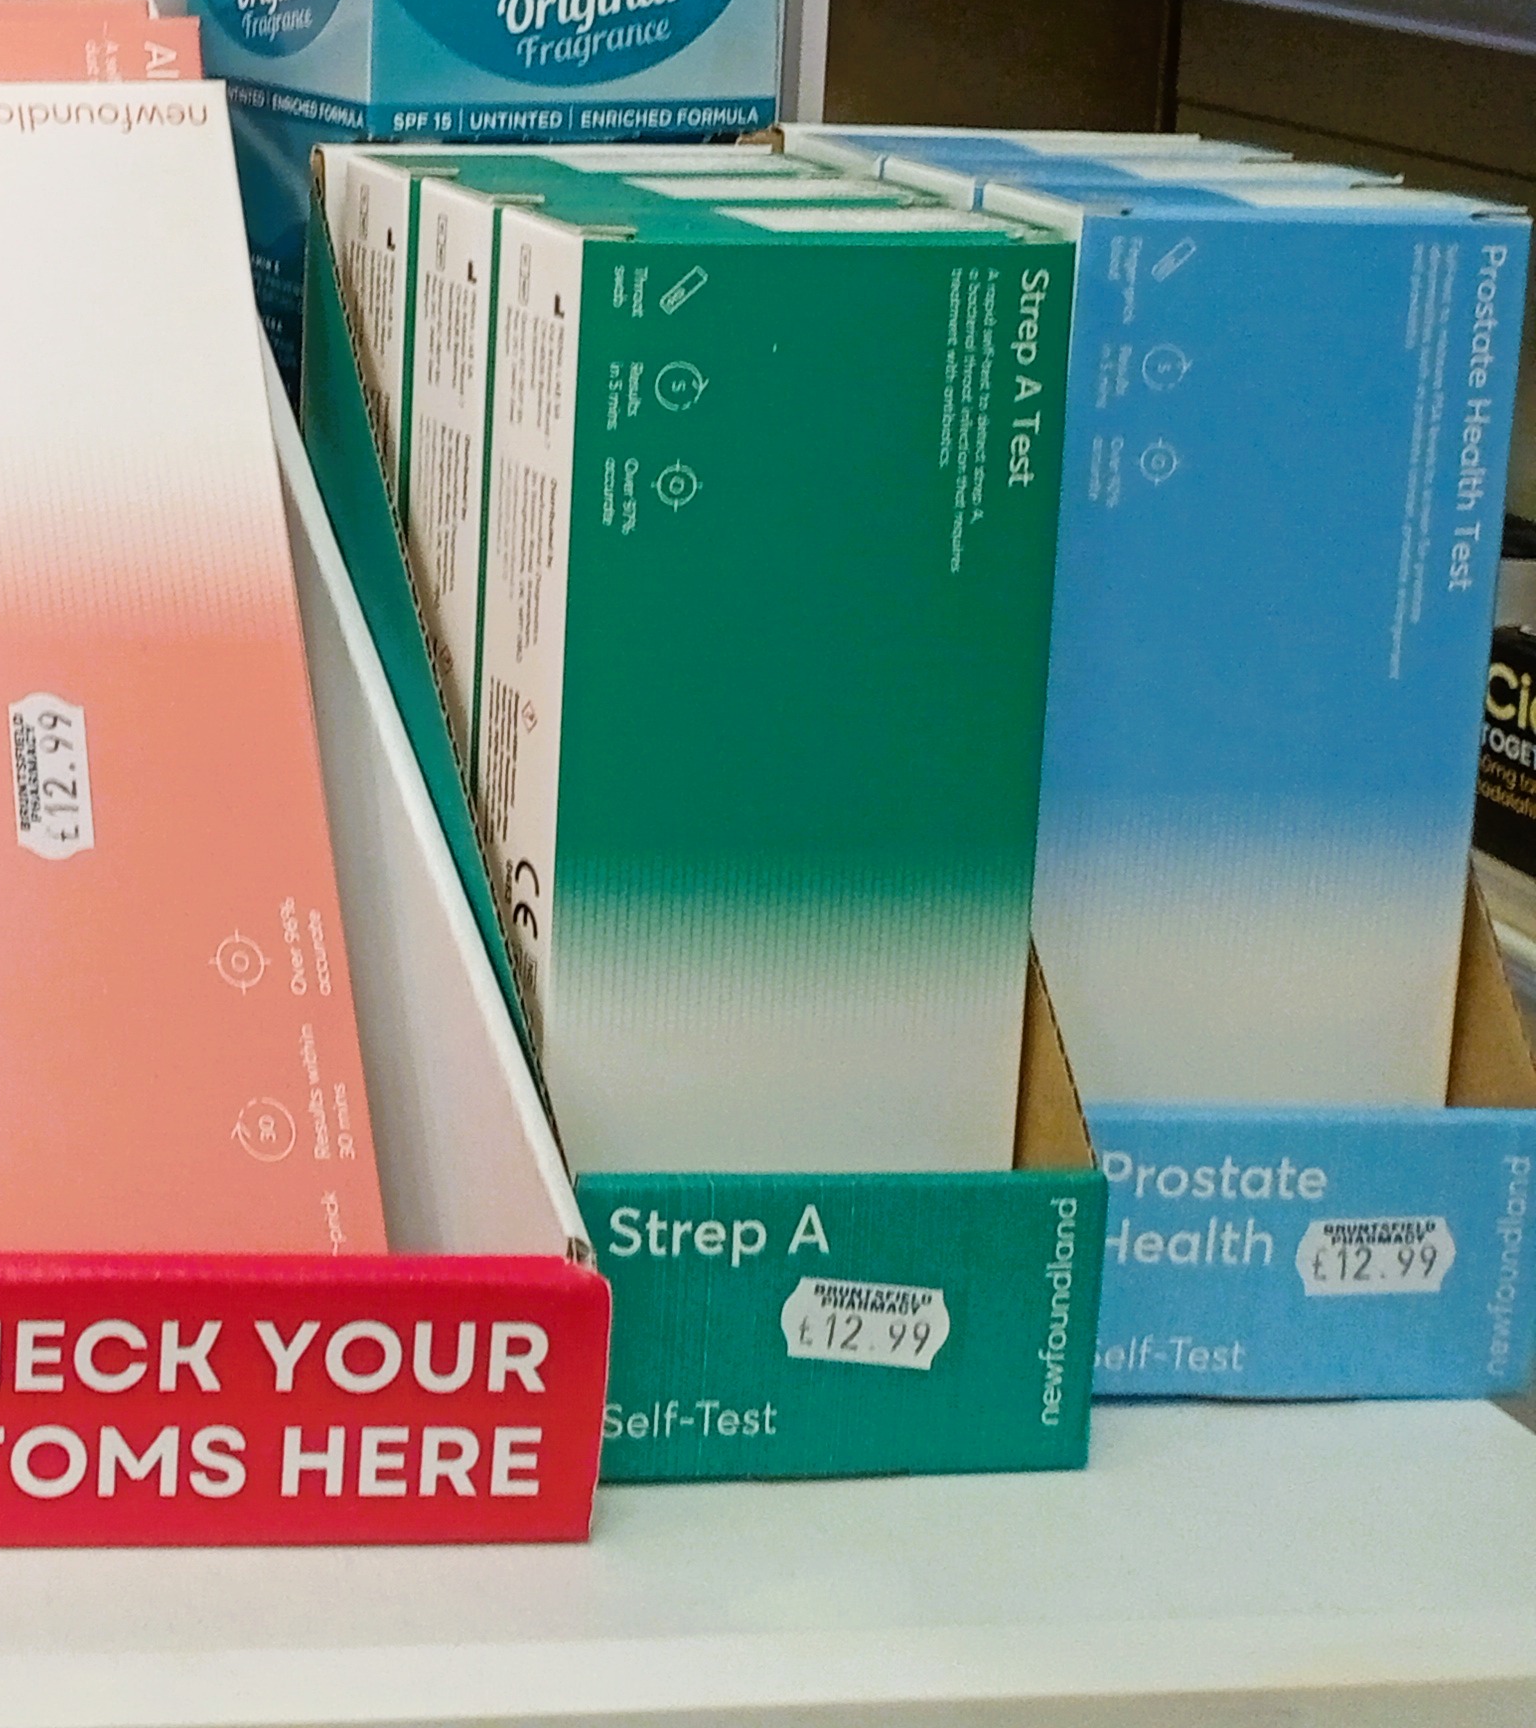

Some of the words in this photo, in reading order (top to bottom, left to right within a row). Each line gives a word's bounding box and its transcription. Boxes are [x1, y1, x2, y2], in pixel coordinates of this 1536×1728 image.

[242, 7, 314, 42] Fragrance
[516, 17, 672, 69] Fragrance
[393, 113, 429, 130] SPF
[469, 111, 564, 131] UNTINTED
[580, 109, 673, 130] ENRICHED
[677, 106, 759, 127] FORMULA
[1009, 267, 1051, 367] Strep
[1468, 243, 1510, 389] Prostate
[1013, 374, 1043, 404] A
[1007, 410, 1042, 488] Test
[1455, 397, 1492, 512] Health
[1447, 519, 1481, 592] Test
[37, 709, 80, 843] £12.99
[1101, 1150, 1328, 1201] Prostate
[608, 1206, 767, 1268] Strep
[787, 1203, 830, 1256] A
[1322, 1221, 1437, 1236] BRUNTSFIELD
[1311, 1244, 1439, 1282] £12.99
[1487, 1154, 1532, 1376] newfoundland
[813, 1284, 934, 1306] BRUNTSFIELD
[820, 1295, 922, 1317] PHARMACY
[1039, 1196, 1079, 1428] newfoundland
[251, 1317, 550, 1394] YOUR
[798, 1313, 932, 1358] £12.99
[602, 1400, 779, 1439] Self-Test
[281, 1425, 542, 1499] HERE
